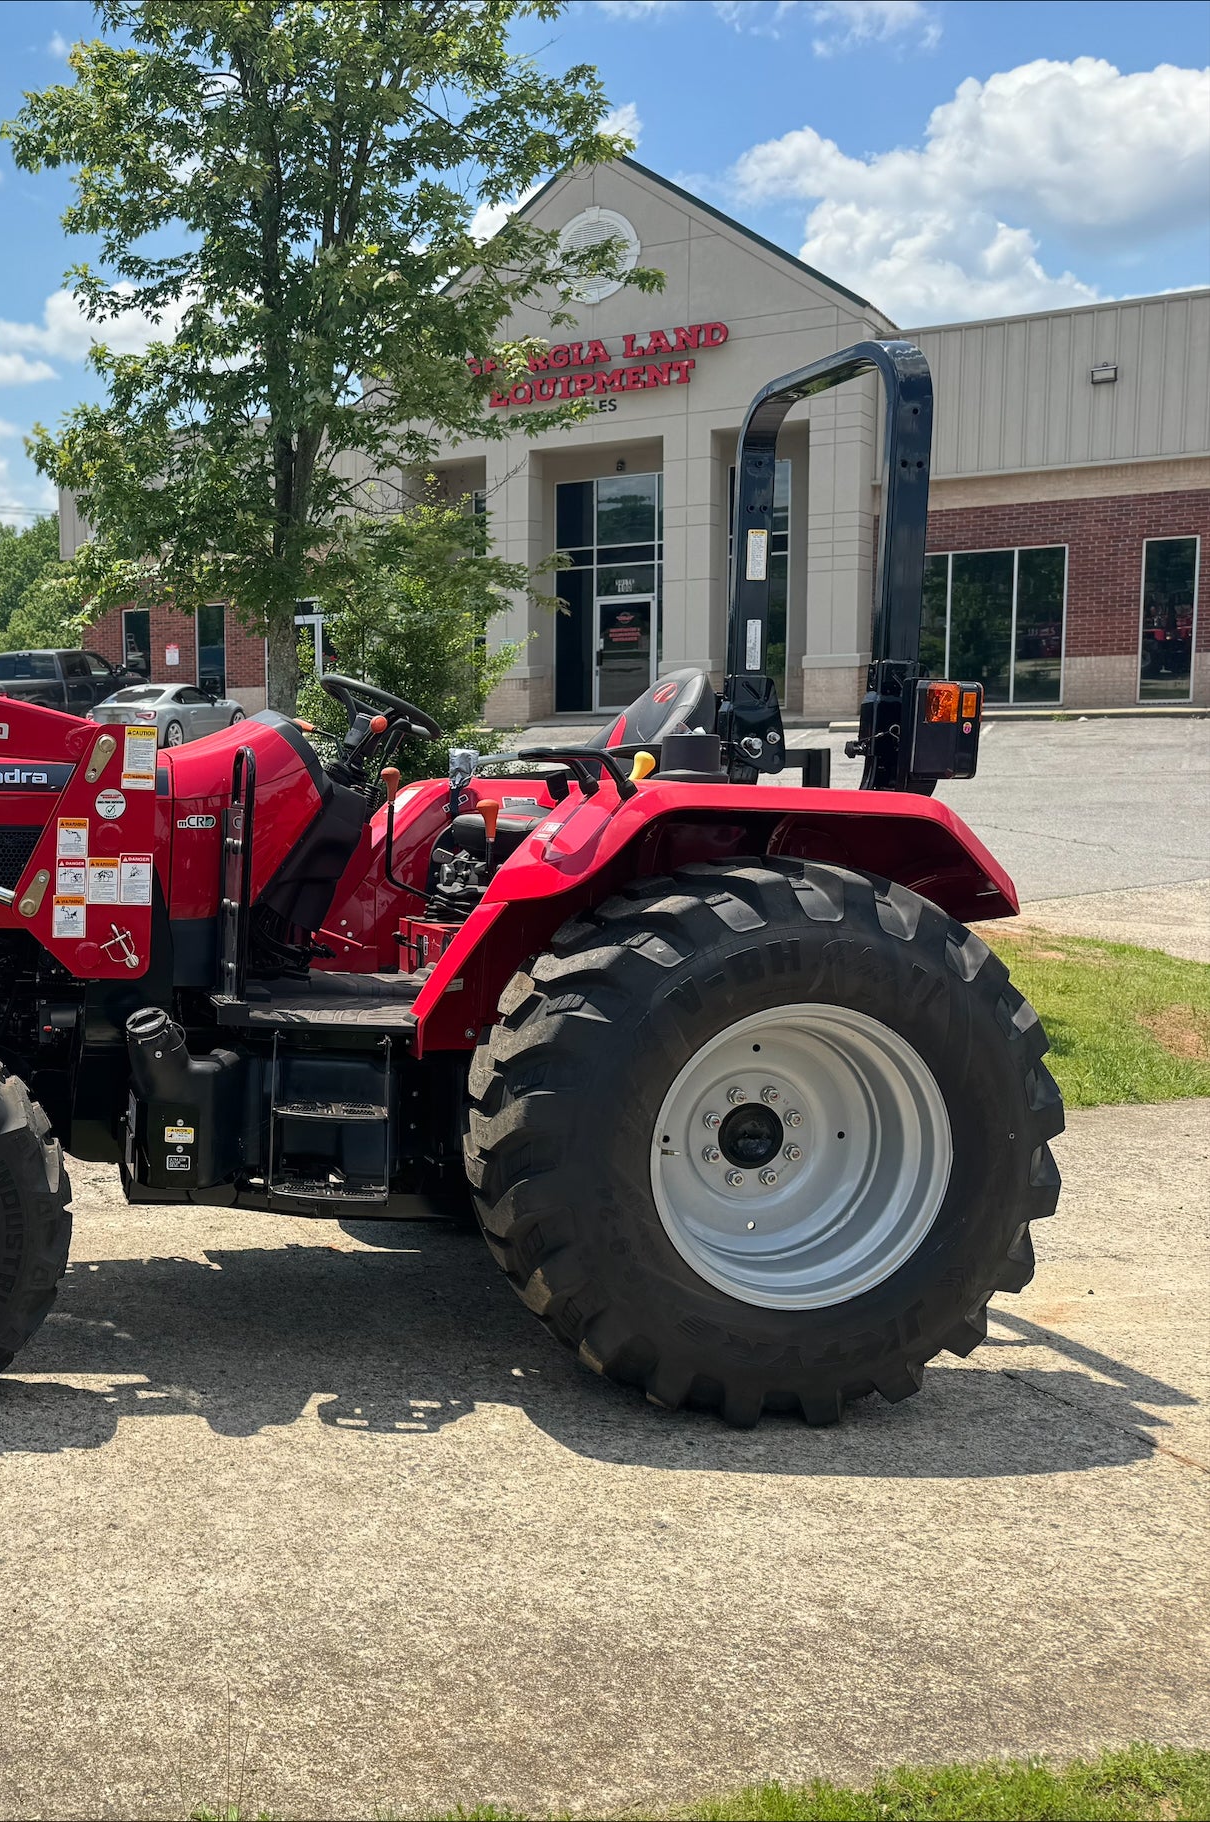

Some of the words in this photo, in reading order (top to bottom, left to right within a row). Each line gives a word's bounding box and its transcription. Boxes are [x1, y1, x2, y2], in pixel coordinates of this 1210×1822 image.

[466, 339, 611, 376] GRGIA
[622, 321, 729, 359] LAND
[488, 359, 695, 407] EQUIPMENT
